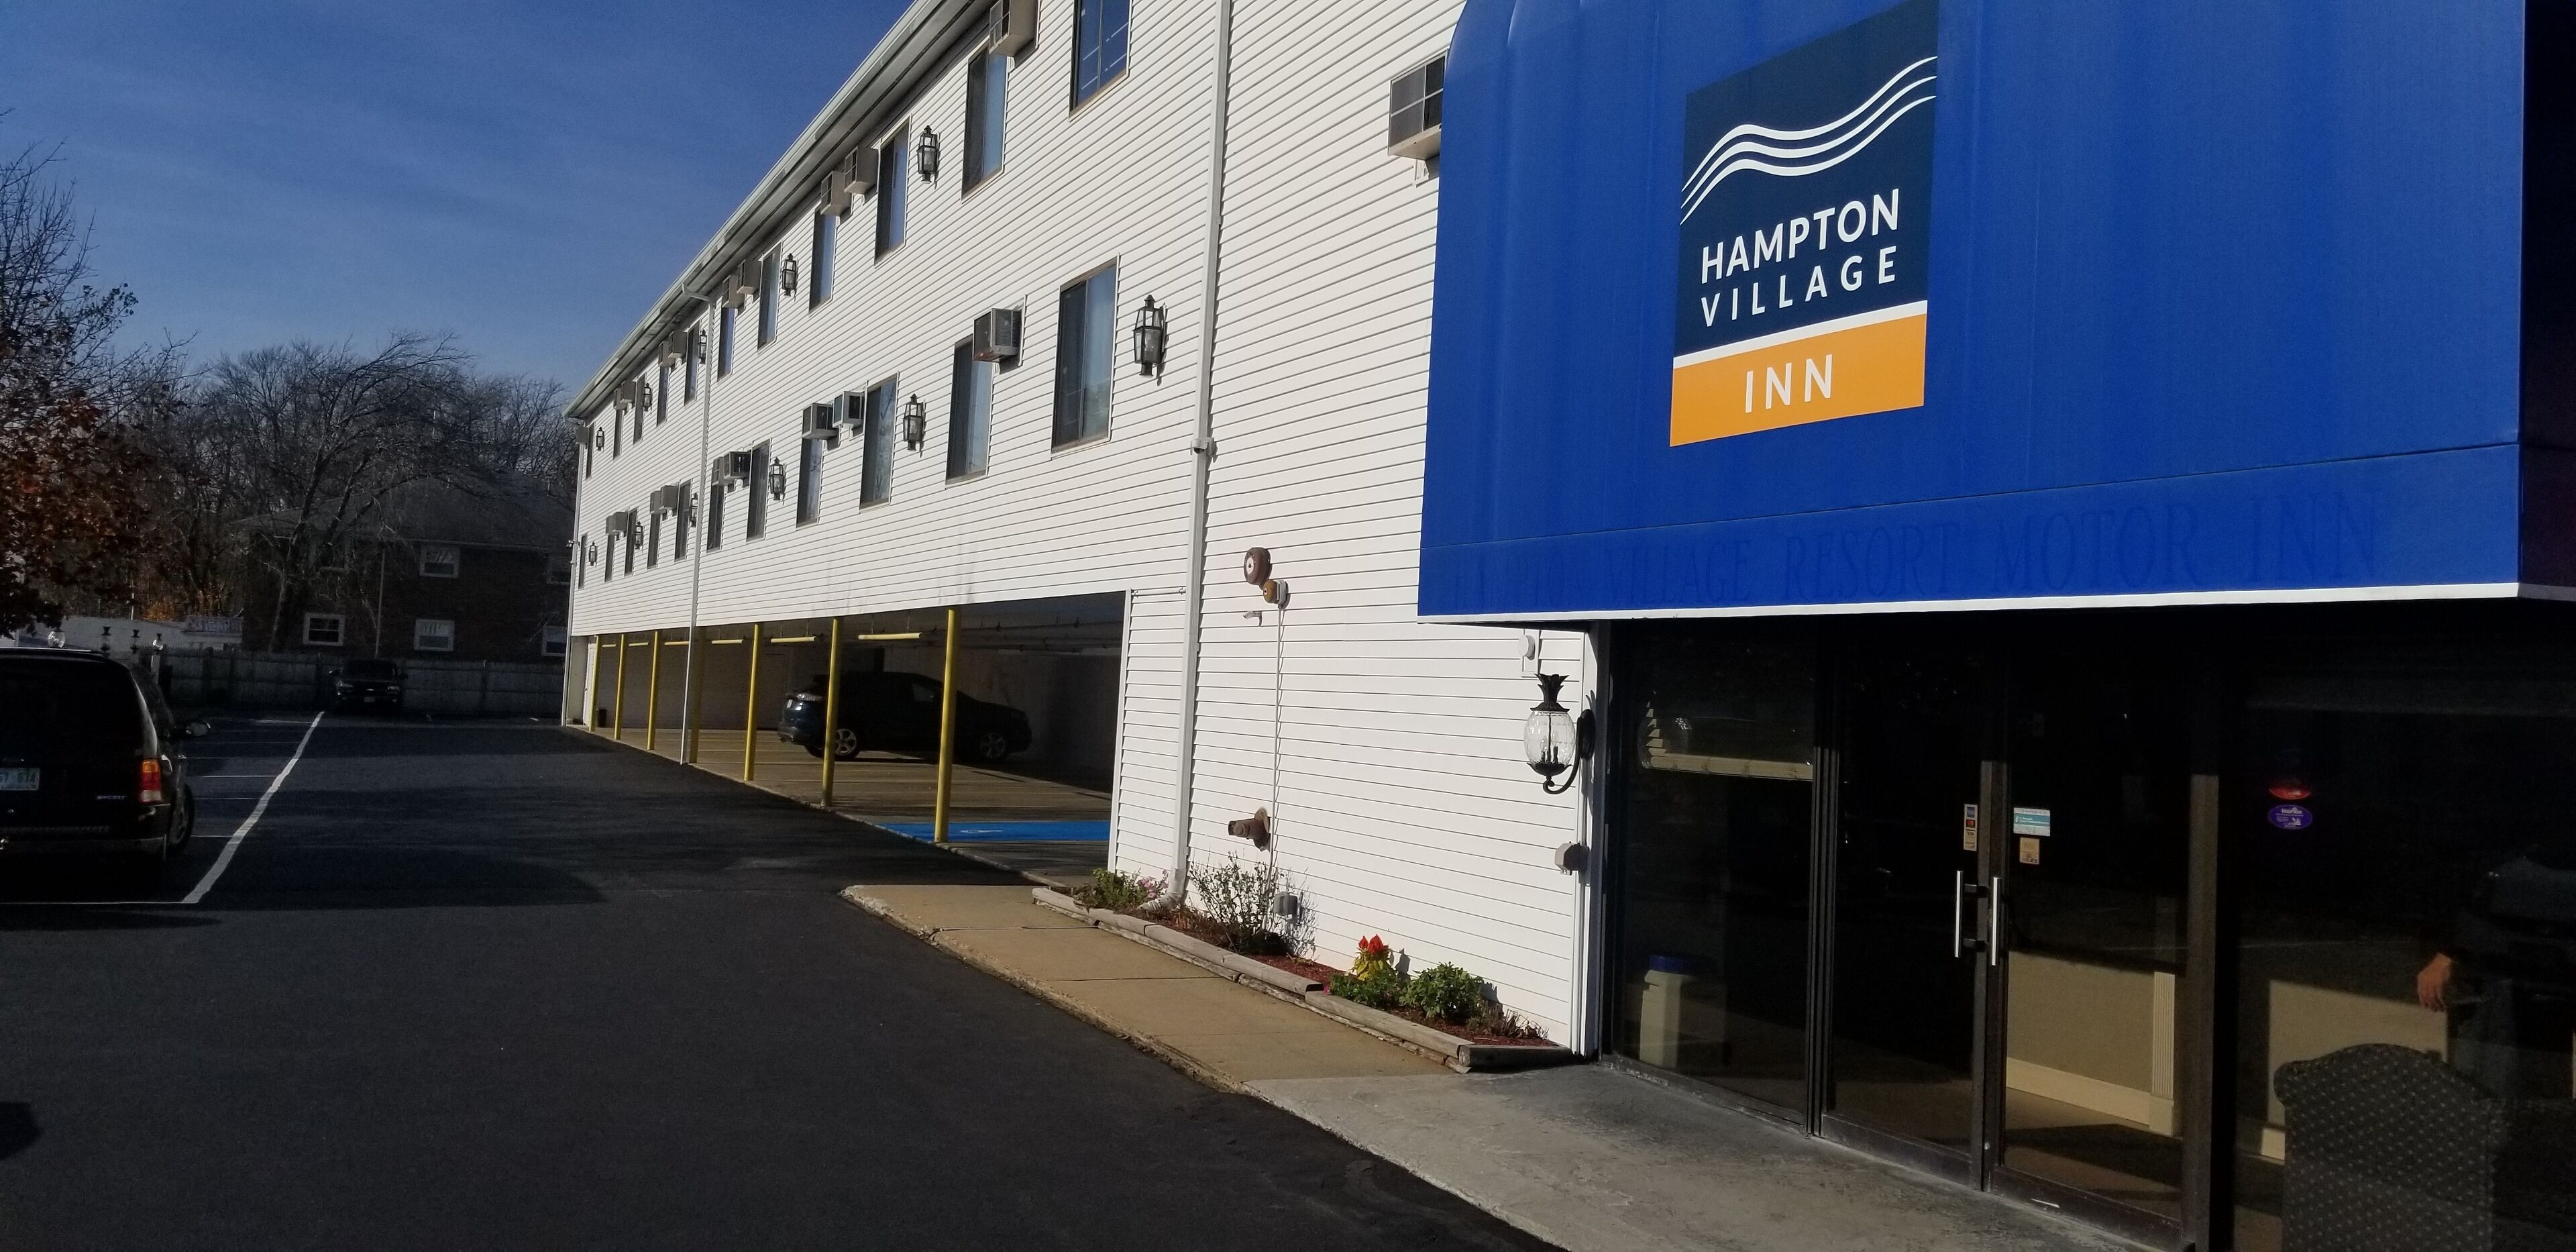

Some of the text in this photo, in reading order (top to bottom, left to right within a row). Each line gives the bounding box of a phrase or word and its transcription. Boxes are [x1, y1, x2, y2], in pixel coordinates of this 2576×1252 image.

[1701, 188, 1899, 284] HAMPTON
[1701, 246, 1898, 327] VILLAGE
[1744, 354, 1833, 413] INN
[1605, 537, 1752, 607] VILLAGE
[1782, 521, 1959, 601] RESORT
[1992, 503, 2206, 594] MOTOR
[2247, 484, 2383, 582] INN
